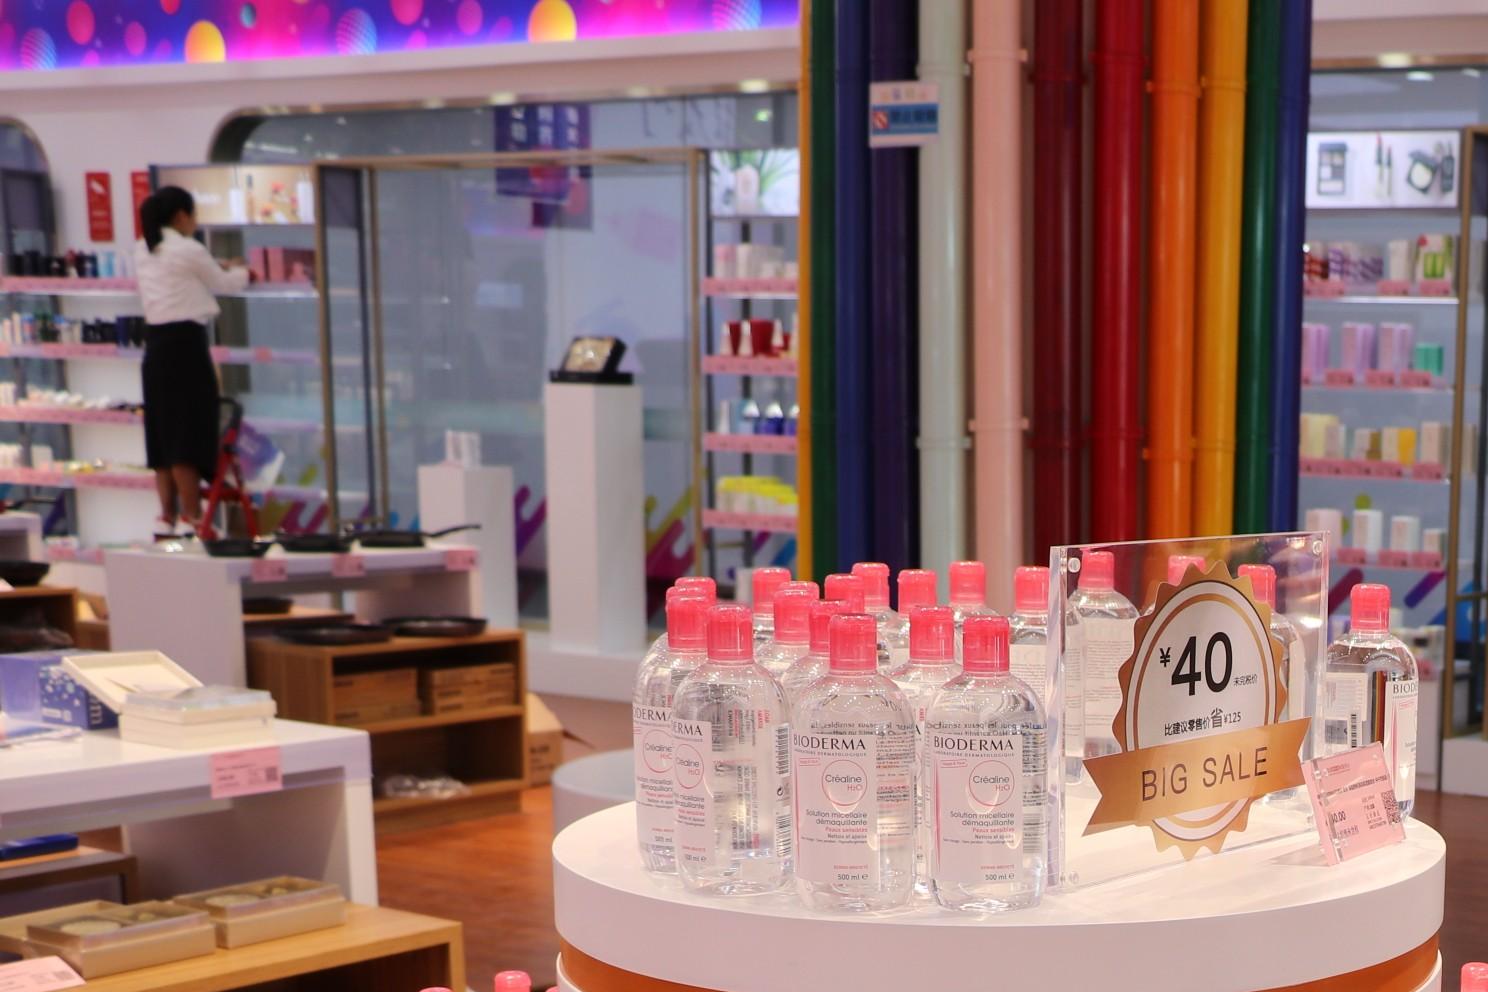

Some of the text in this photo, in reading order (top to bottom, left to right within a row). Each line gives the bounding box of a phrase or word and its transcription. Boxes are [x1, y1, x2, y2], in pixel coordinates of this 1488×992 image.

[794, 735, 866, 750] BIODERMA
[934, 736, 1014, 750] BIODERMA
[825, 774, 862, 783] Créaline
[972, 776, 1010, 784] Créaline
[1142, 747, 1268, 802] BIG SALE
